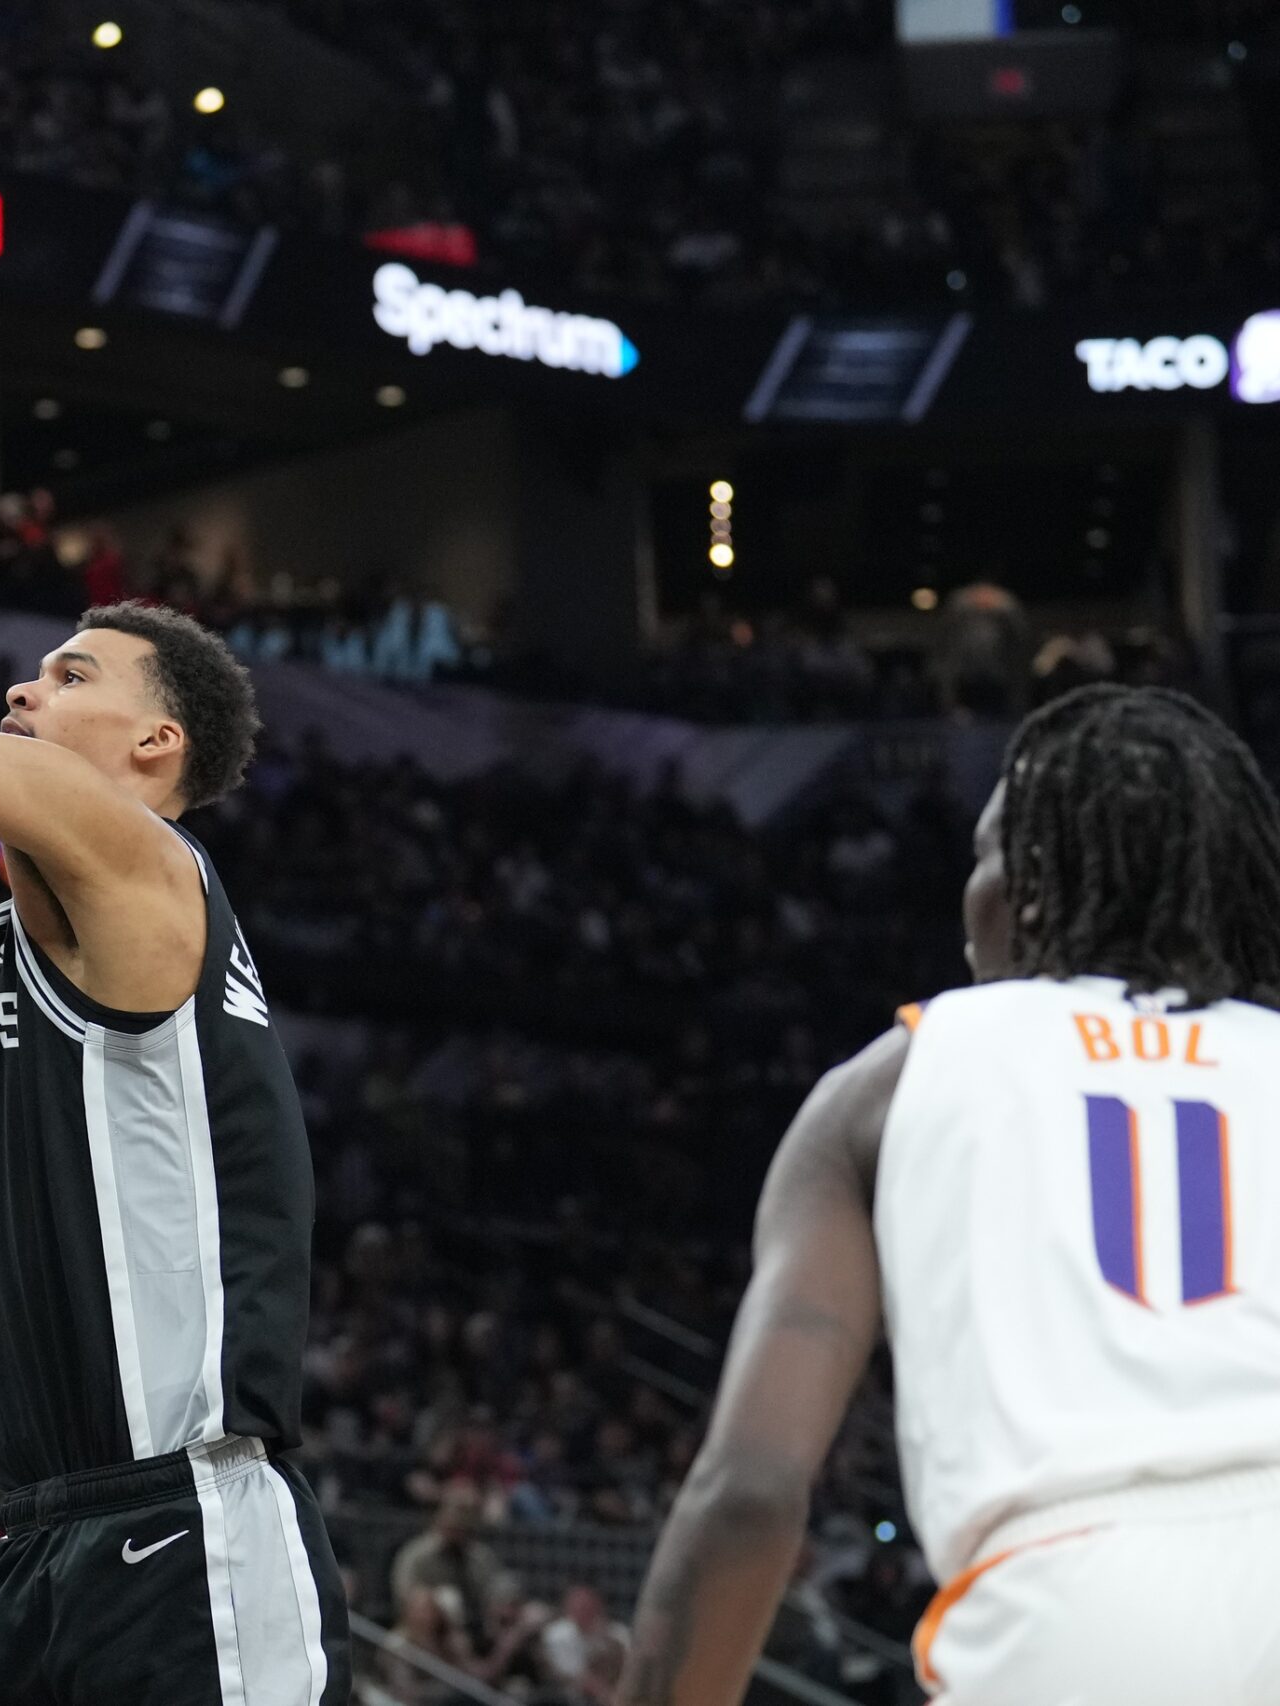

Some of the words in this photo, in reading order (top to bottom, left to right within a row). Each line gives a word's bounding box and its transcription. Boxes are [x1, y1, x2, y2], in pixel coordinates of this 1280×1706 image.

[372, 262, 624, 379] Spectrum
[1074, 334, 1229, 392] TACO
[1072, 1011, 1219, 1067] BOL
[1082, 1092, 1240, 1313] 11
